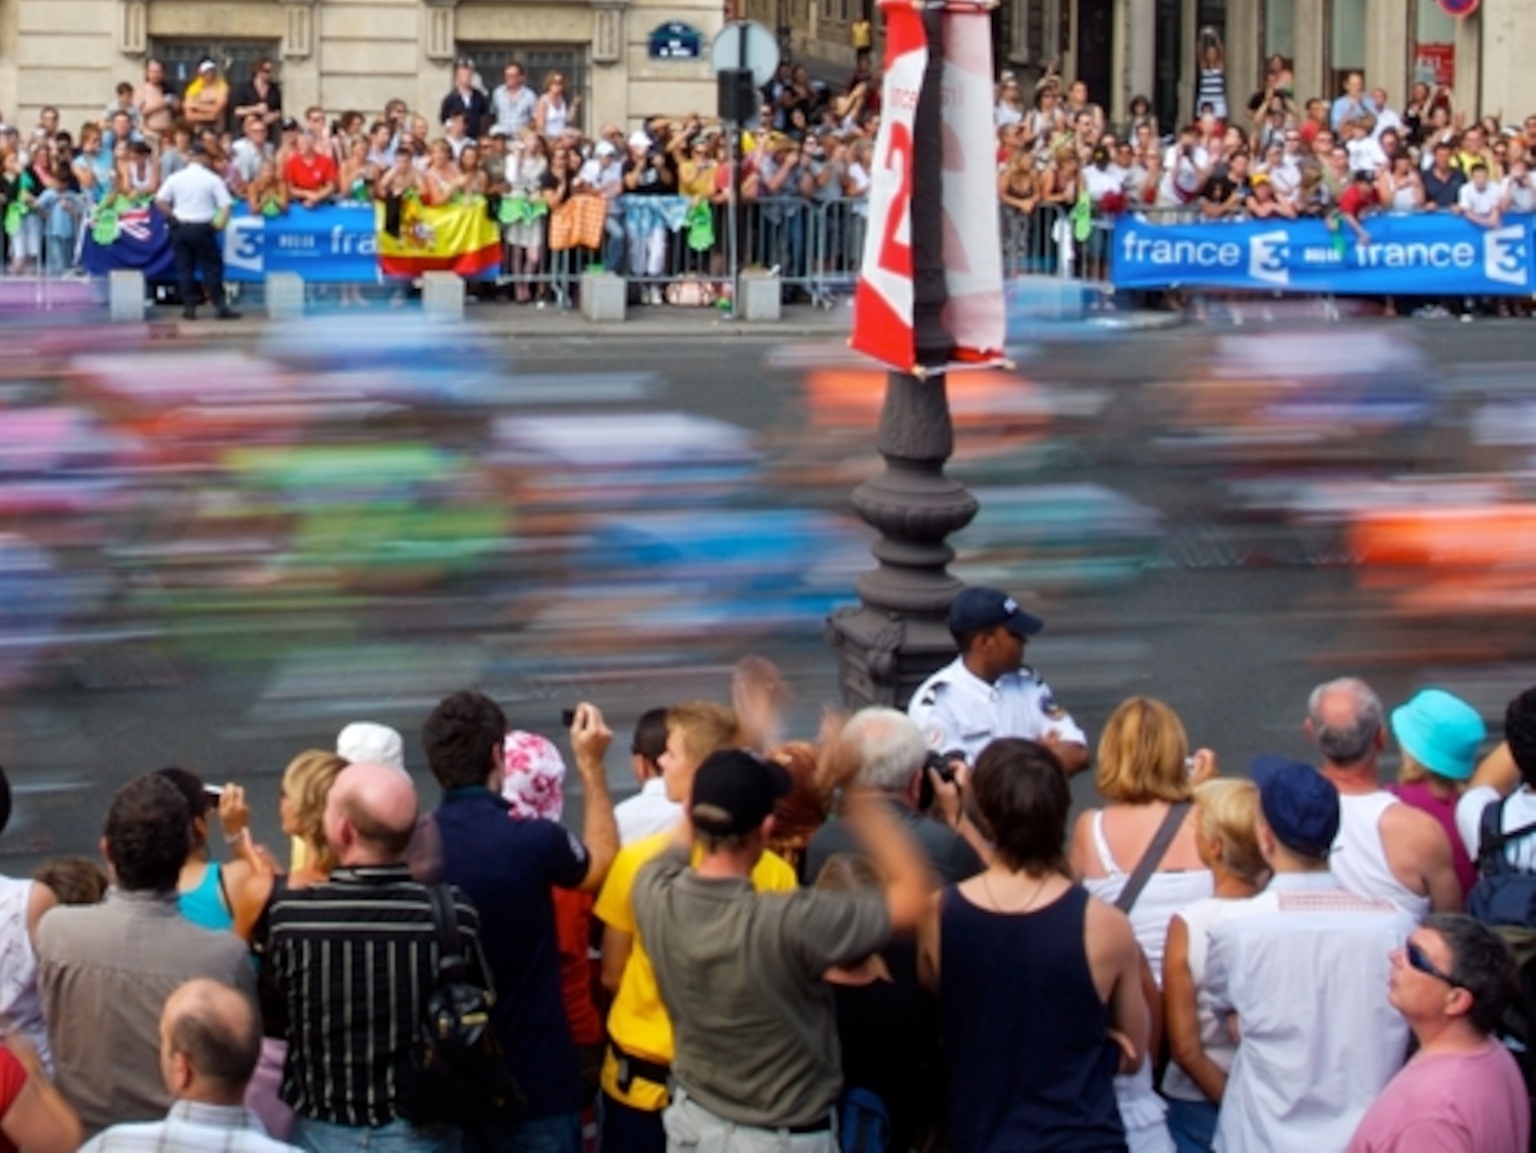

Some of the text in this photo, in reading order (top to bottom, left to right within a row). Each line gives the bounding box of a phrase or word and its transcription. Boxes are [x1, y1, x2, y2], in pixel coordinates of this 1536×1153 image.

[331, 223, 378, 255] fra
[1122, 230, 1241, 266] france
[1355, 241, 1476, 268] france
